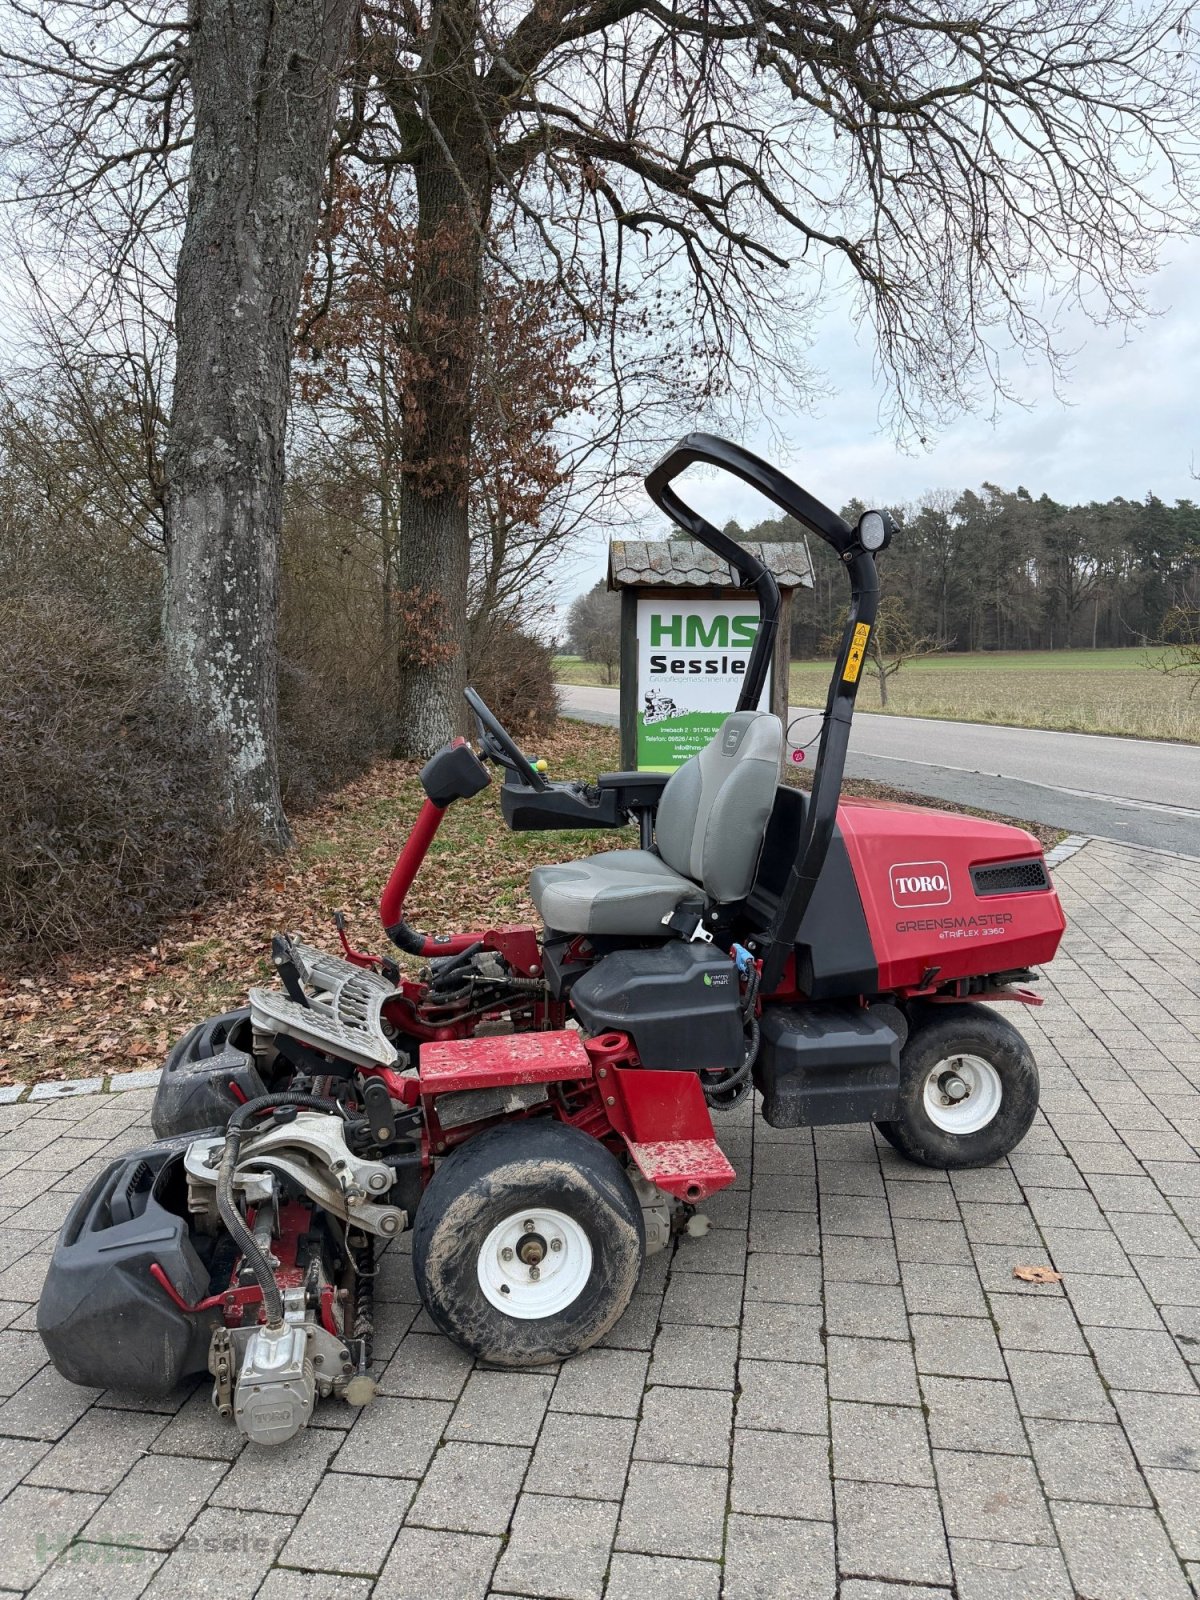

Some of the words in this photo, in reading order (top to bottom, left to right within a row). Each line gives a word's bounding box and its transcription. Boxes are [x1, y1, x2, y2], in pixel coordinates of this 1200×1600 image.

[650, 614, 759, 648] HMS
[650, 655, 746, 674] Sessle
[895, 875, 945, 894] TORO
[895, 913, 1013, 933] GREENSMASTER
[981, 927, 1005, 937] 3360
